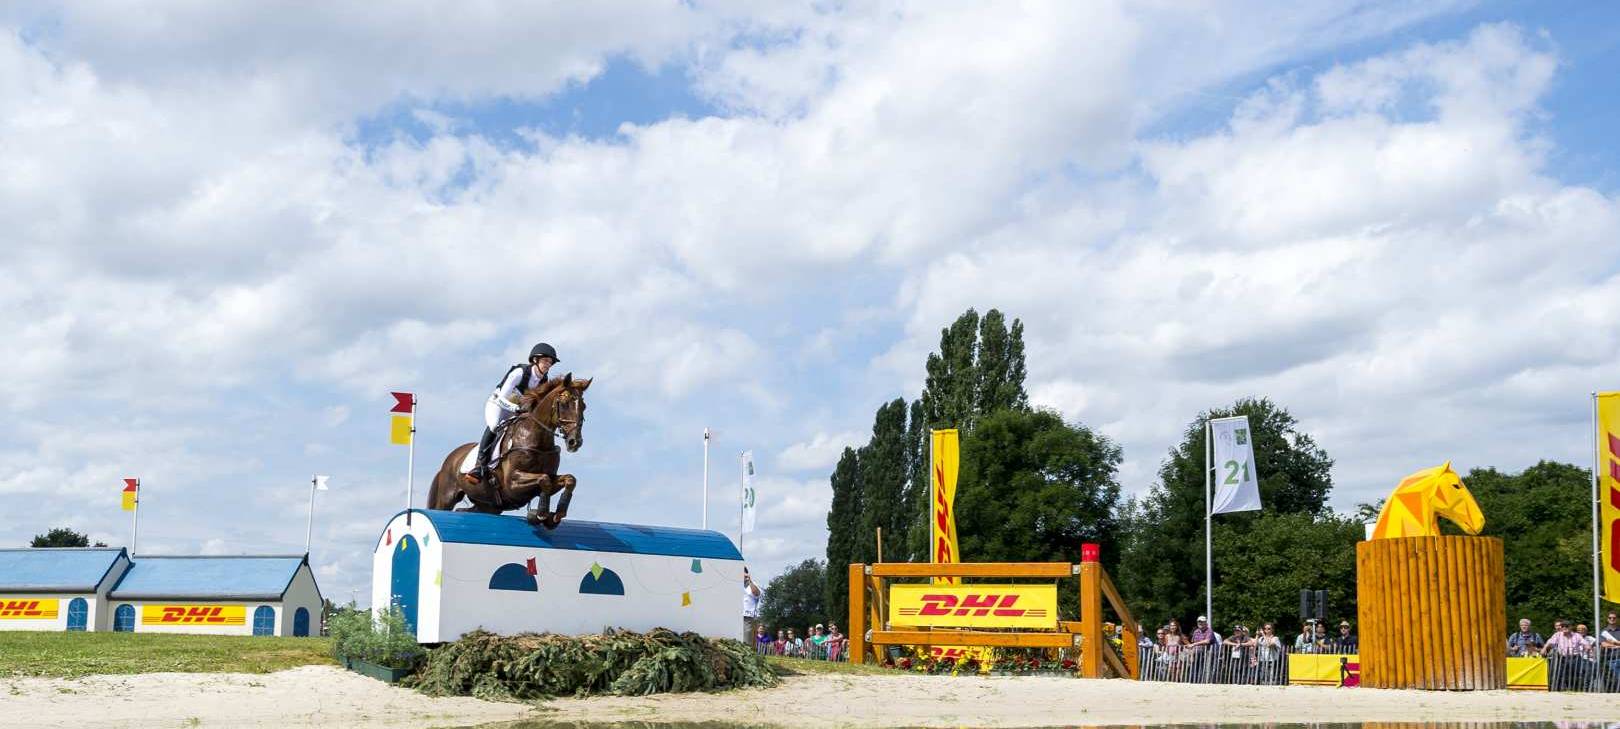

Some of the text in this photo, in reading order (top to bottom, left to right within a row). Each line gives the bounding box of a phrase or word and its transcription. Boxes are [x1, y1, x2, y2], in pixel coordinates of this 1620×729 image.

[1224, 460, 1251, 485] 21
[0, 601, 42, 616] HL
[918, 594, 1025, 616] DHL
[161, 607, 226, 623] DHL
